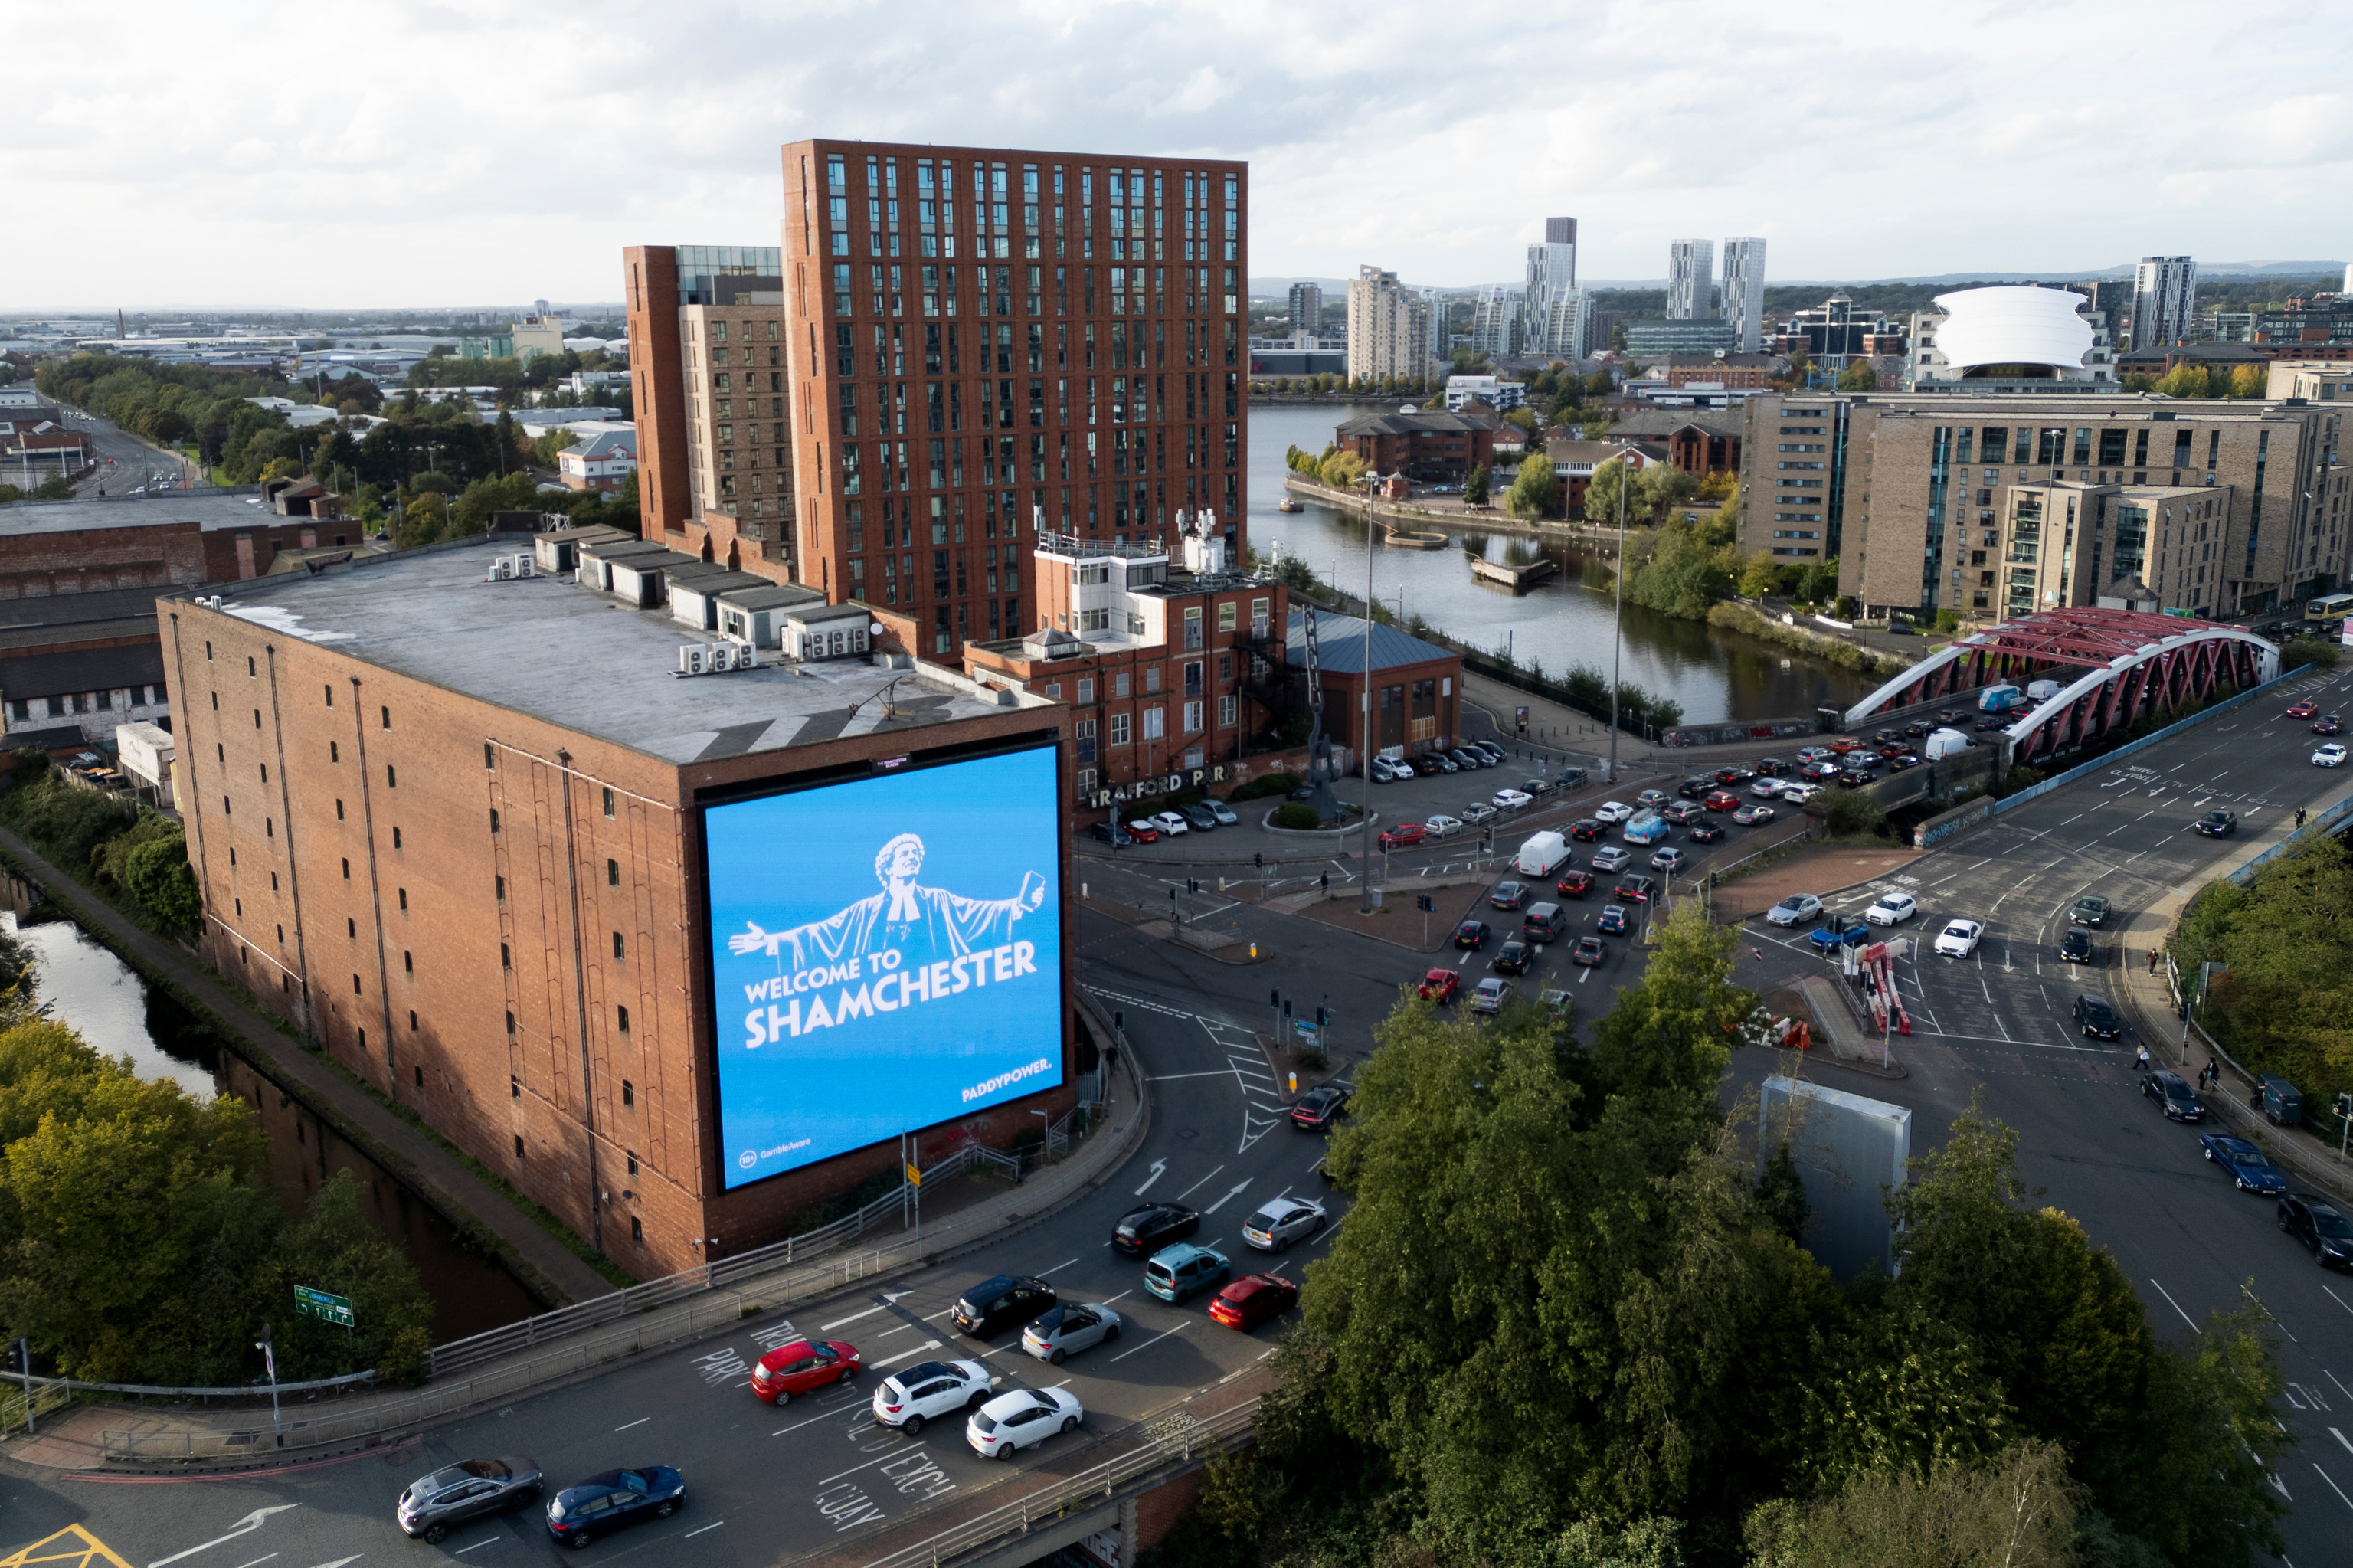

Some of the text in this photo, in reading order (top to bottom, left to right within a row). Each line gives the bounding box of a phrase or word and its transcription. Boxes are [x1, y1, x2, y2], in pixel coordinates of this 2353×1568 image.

[1089, 774, 1182, 808] TRAFFORD
[1193, 764, 1235, 786] PARK
[744, 949, 902, 1004] WELCOME TO
[745, 941, 1037, 1049] SHAMCHESTER
[761, 1138, 810, 1159] GambleAware
[690, 1347, 752, 1388] PARK
[880, 1452, 957, 1504] EXCH
[812, 1482, 885, 1533] QUAY
